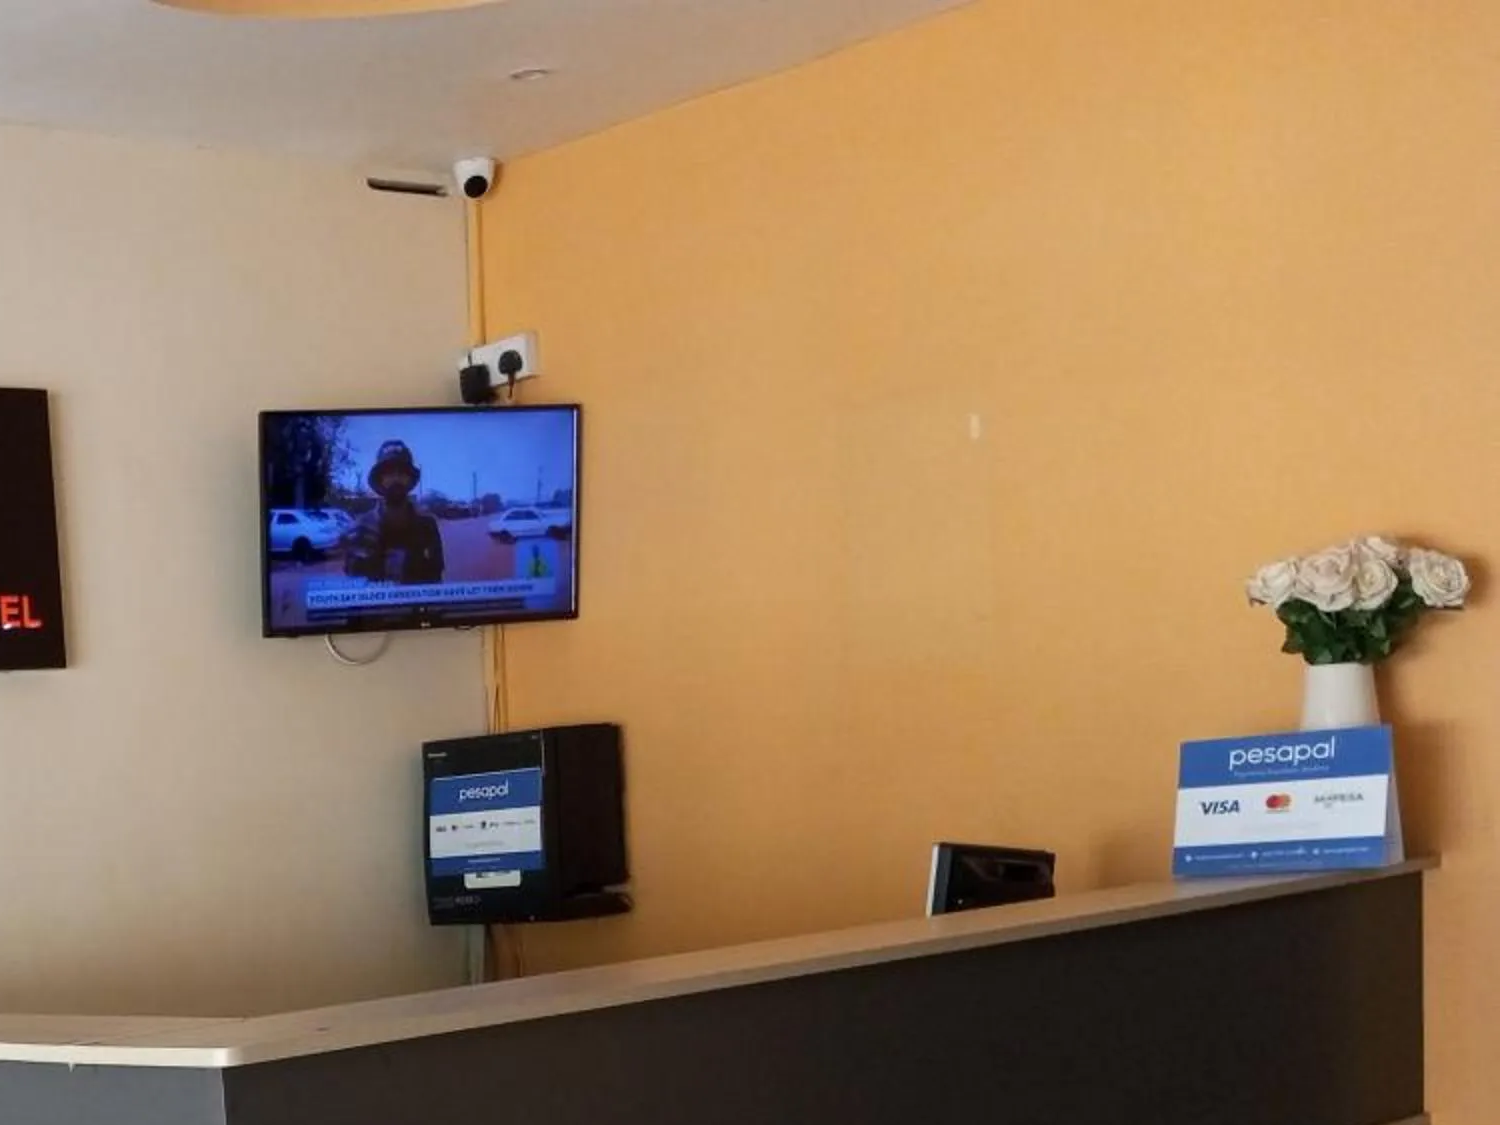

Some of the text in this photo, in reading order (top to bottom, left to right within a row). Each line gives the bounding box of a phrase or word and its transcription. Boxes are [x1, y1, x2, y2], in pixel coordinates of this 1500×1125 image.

[1229, 736, 1336, 770] pesapal
[458, 777, 509, 803] pesapal
[1201, 799, 1241, 816] VISA
